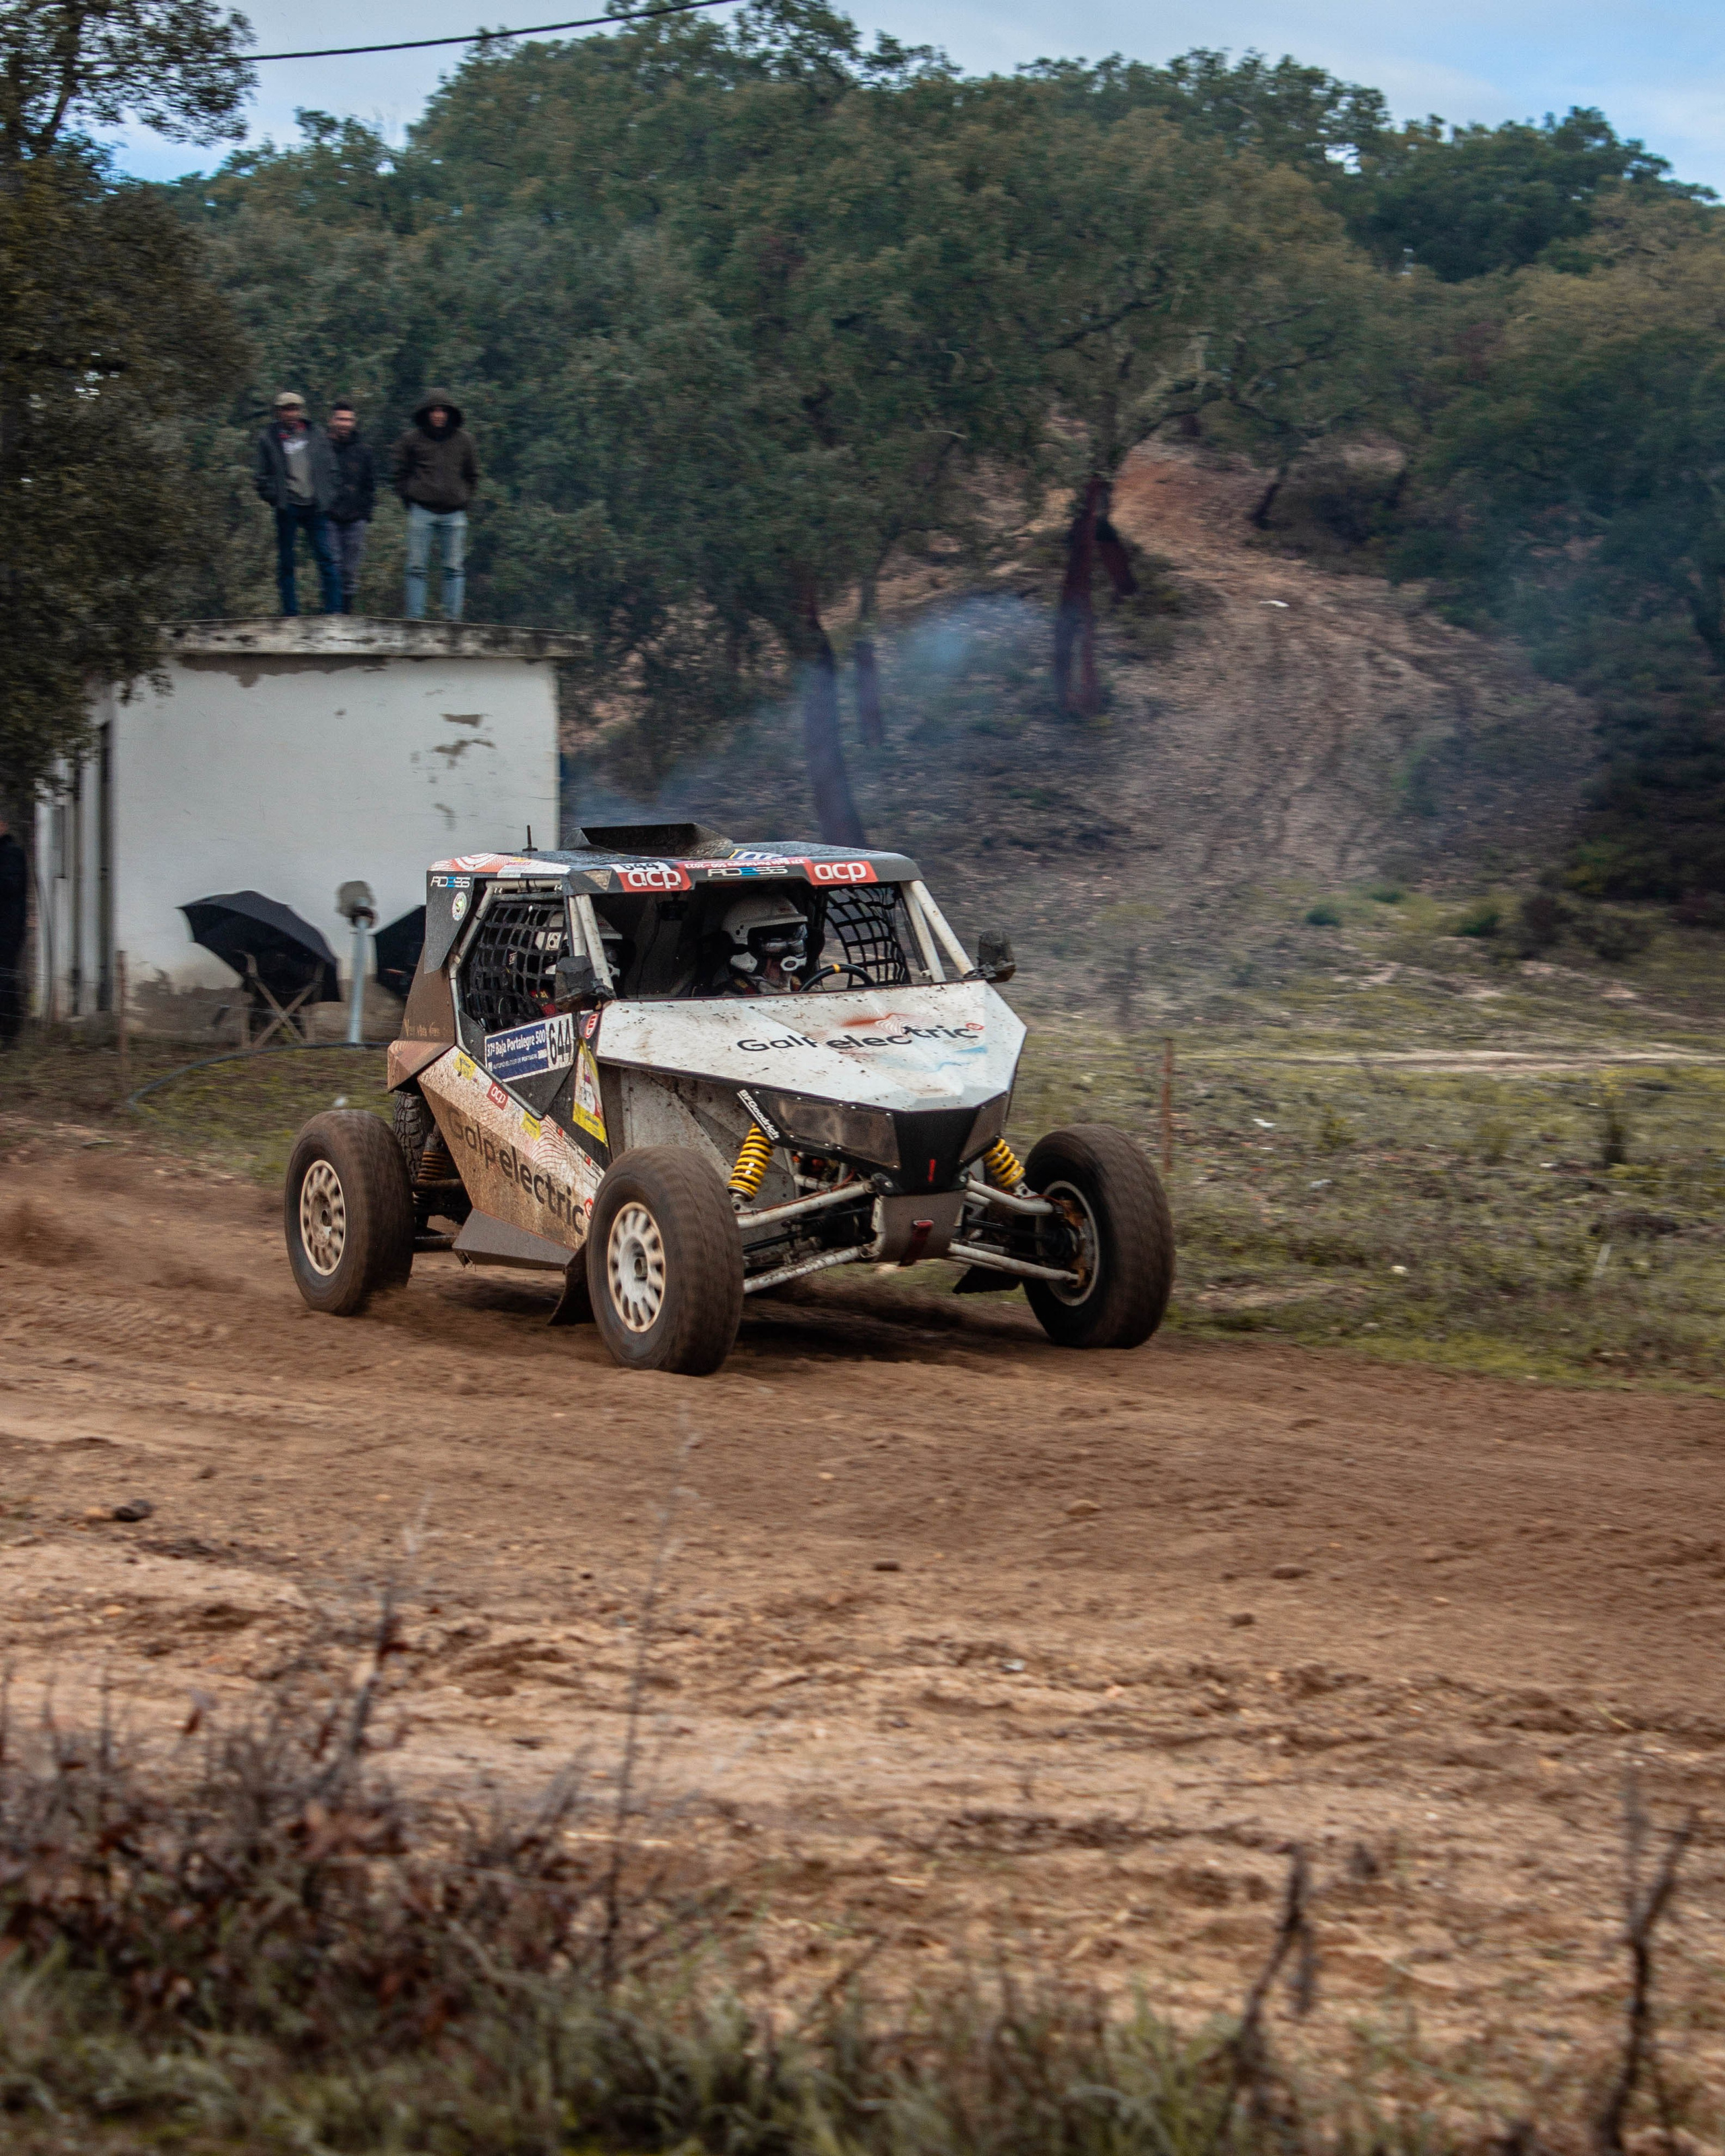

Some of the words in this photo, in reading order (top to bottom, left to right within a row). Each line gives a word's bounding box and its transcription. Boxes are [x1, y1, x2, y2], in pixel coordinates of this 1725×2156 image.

[627, 870, 682, 889] acp
[813, 862, 867, 882] acp
[495, 1040, 507, 1057] Baja
[507, 1034, 535, 1051] Portalegre
[535, 1029, 546, 1045] 500
[548, 1018, 571, 1065] 644
[491, 1086, 506, 1104] acp
[739, 1089, 780, 1139] BFGoodrich
